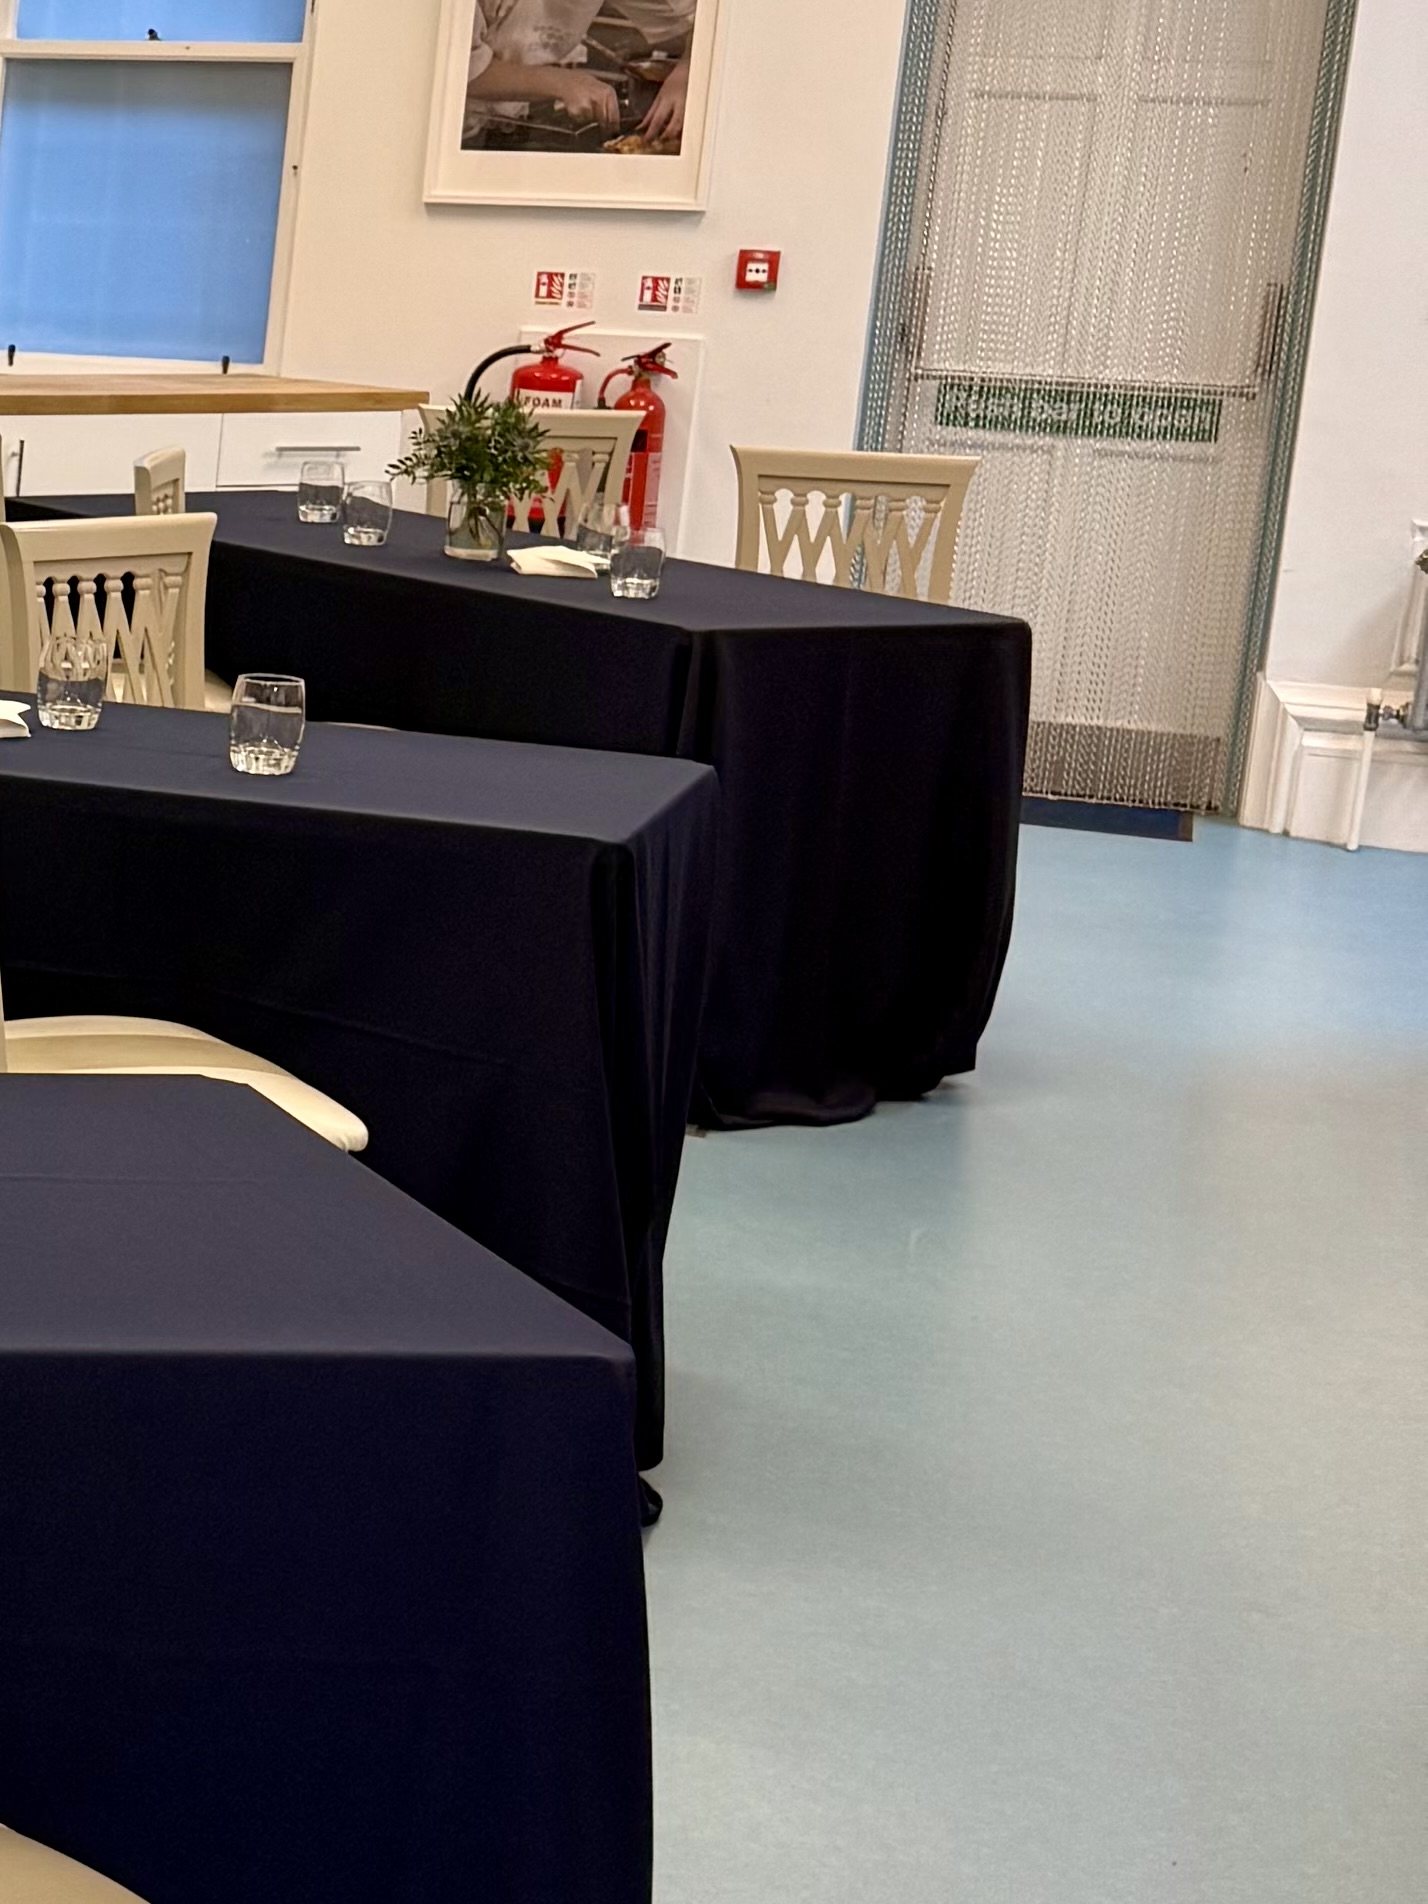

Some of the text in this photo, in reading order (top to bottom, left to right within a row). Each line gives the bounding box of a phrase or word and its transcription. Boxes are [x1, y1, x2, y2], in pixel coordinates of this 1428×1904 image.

[524, 396, 562, 409] FOAM
[944, 390, 1212, 434] Push bar to open
